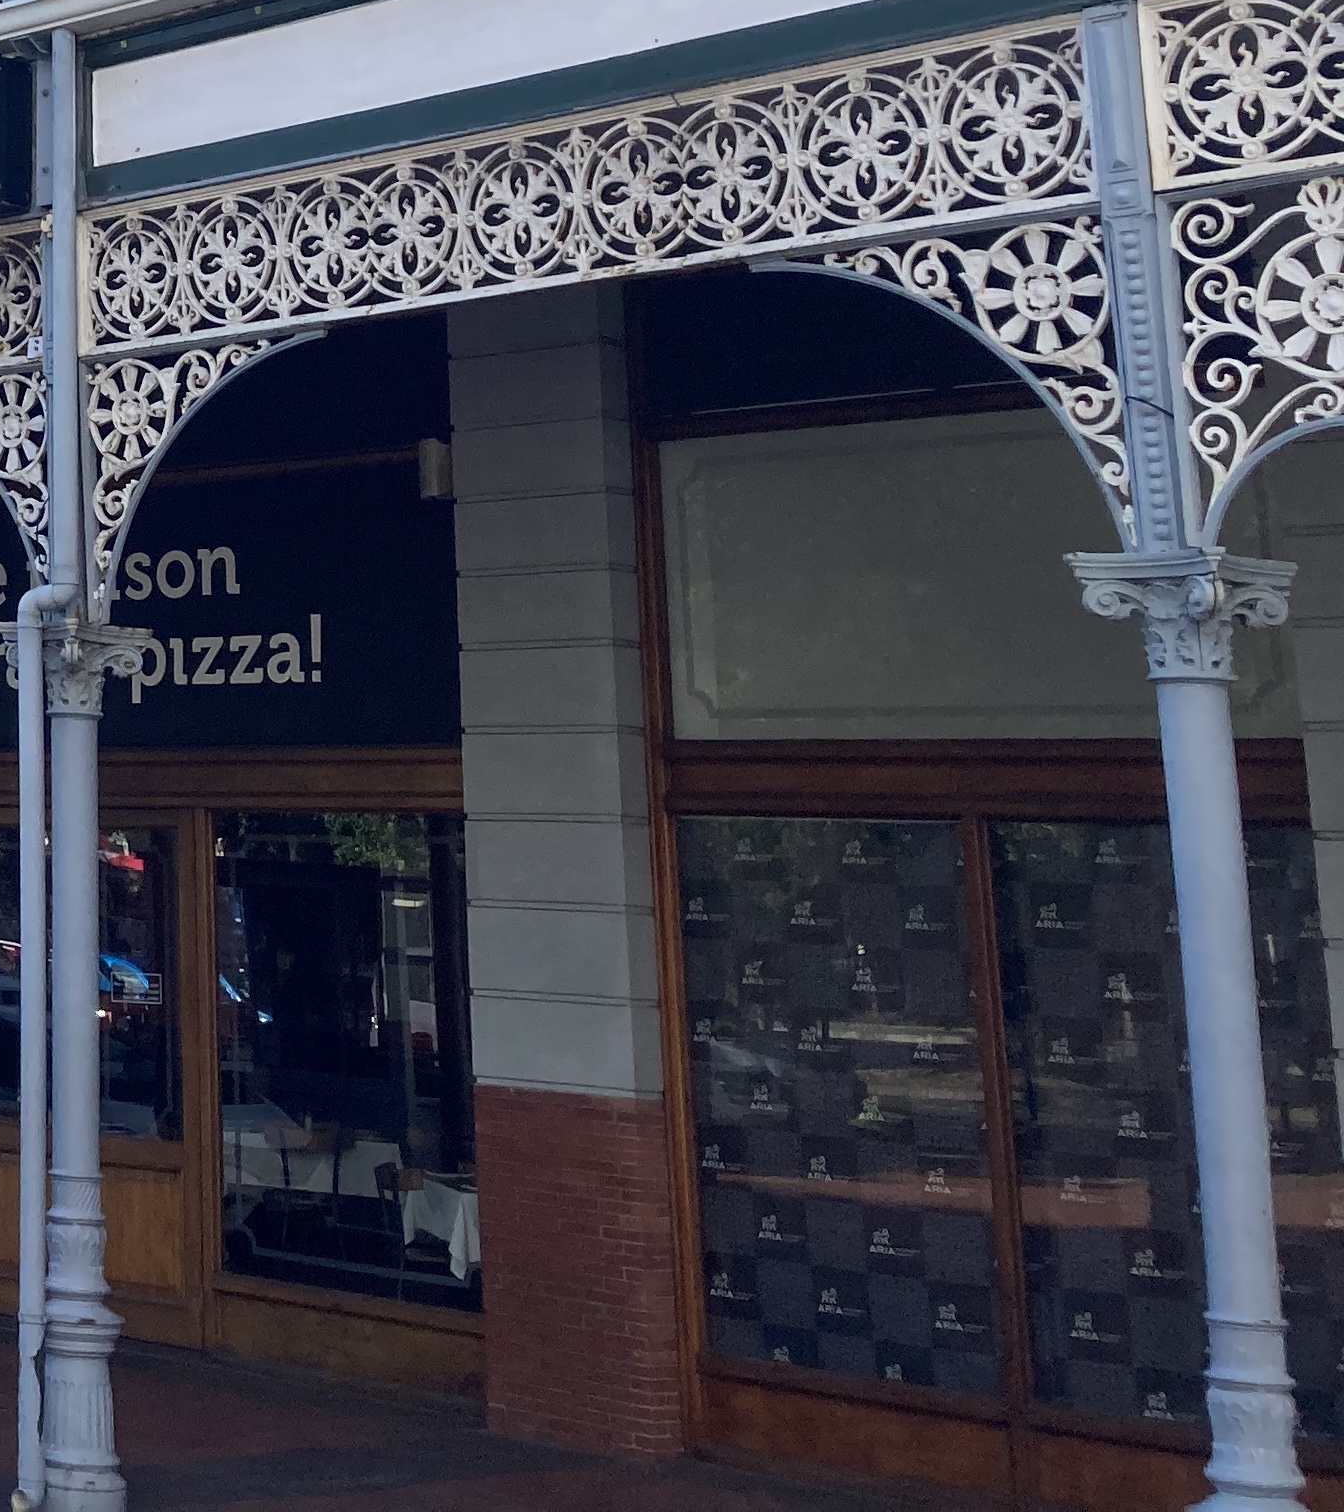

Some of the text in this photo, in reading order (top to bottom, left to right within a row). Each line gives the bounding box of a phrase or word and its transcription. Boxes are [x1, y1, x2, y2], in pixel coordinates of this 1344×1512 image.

[27, 546, 241, 601] son
[734, 854, 755, 862] ARIA
[842, 857, 867, 865] ARIA
[686, 913, 708, 921] ARIA
[790, 917, 816, 926] ARIA
[905, 922, 929, 930] ARIA
[1035, 919, 1064, 929] ARIA
[742, 977, 764, 985] ARIA
[852, 983, 877, 992] ARIA
[798, 1043, 822, 1051] ARIA
[913, 1051, 939, 1060] ARIA
[750, 1102, 773, 1111] ARIA
[858, 1112, 885, 1122] ARIA
[1117, 1128, 1148, 1139] ARIA
[701, 1160, 725, 1169] ARIA
[808, 1172, 832, 1182] ARIA
[924, 1184, 951, 1194] ARIA
[1060, 1192, 1087, 1203] ARIA
[758, 1231, 782, 1241] ARIA
[869, 1245, 896, 1255] ARIA
[1130, 1267, 1161, 1277] ARIA
[710, 1288, 734, 1298] ARIA
[818, 1305, 843, 1315] ARIA
[935, 1320, 963, 1331] ARIA
[1069, 1330, 1099, 1340] ARIA
